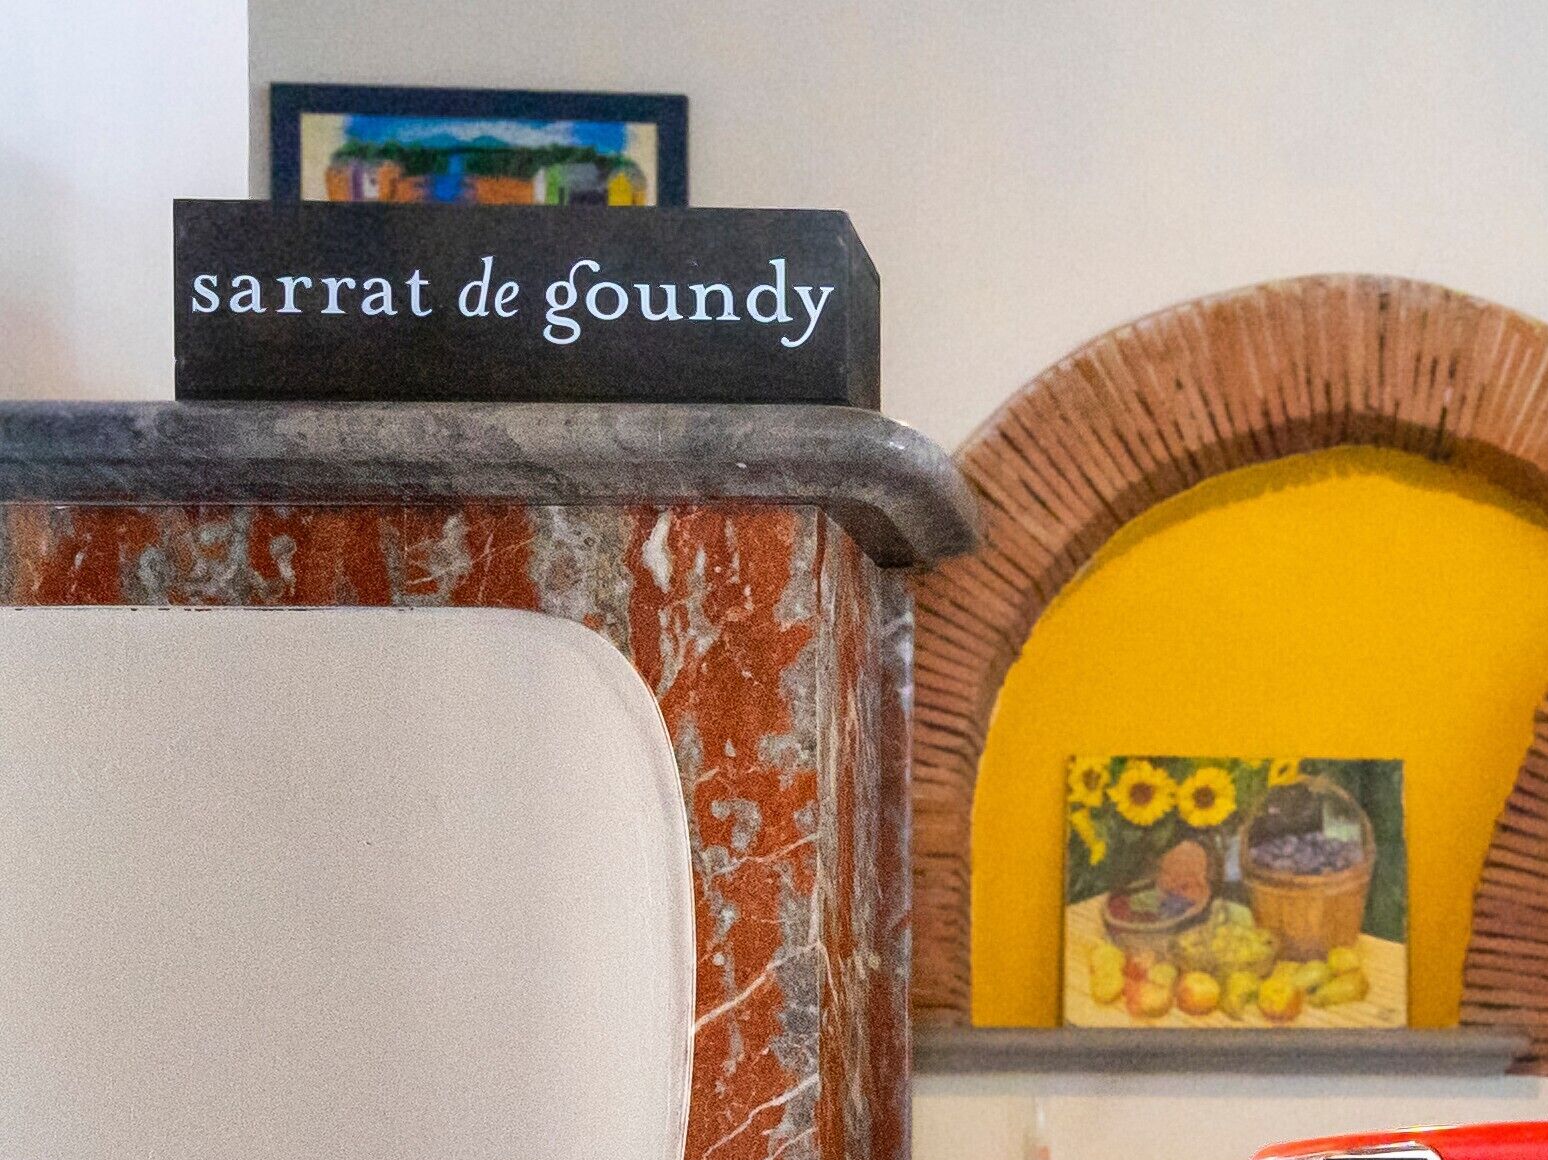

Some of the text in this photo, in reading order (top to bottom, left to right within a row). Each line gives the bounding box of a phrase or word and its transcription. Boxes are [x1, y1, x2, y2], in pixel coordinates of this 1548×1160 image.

[190, 255, 835, 348] sarrat de goundy
